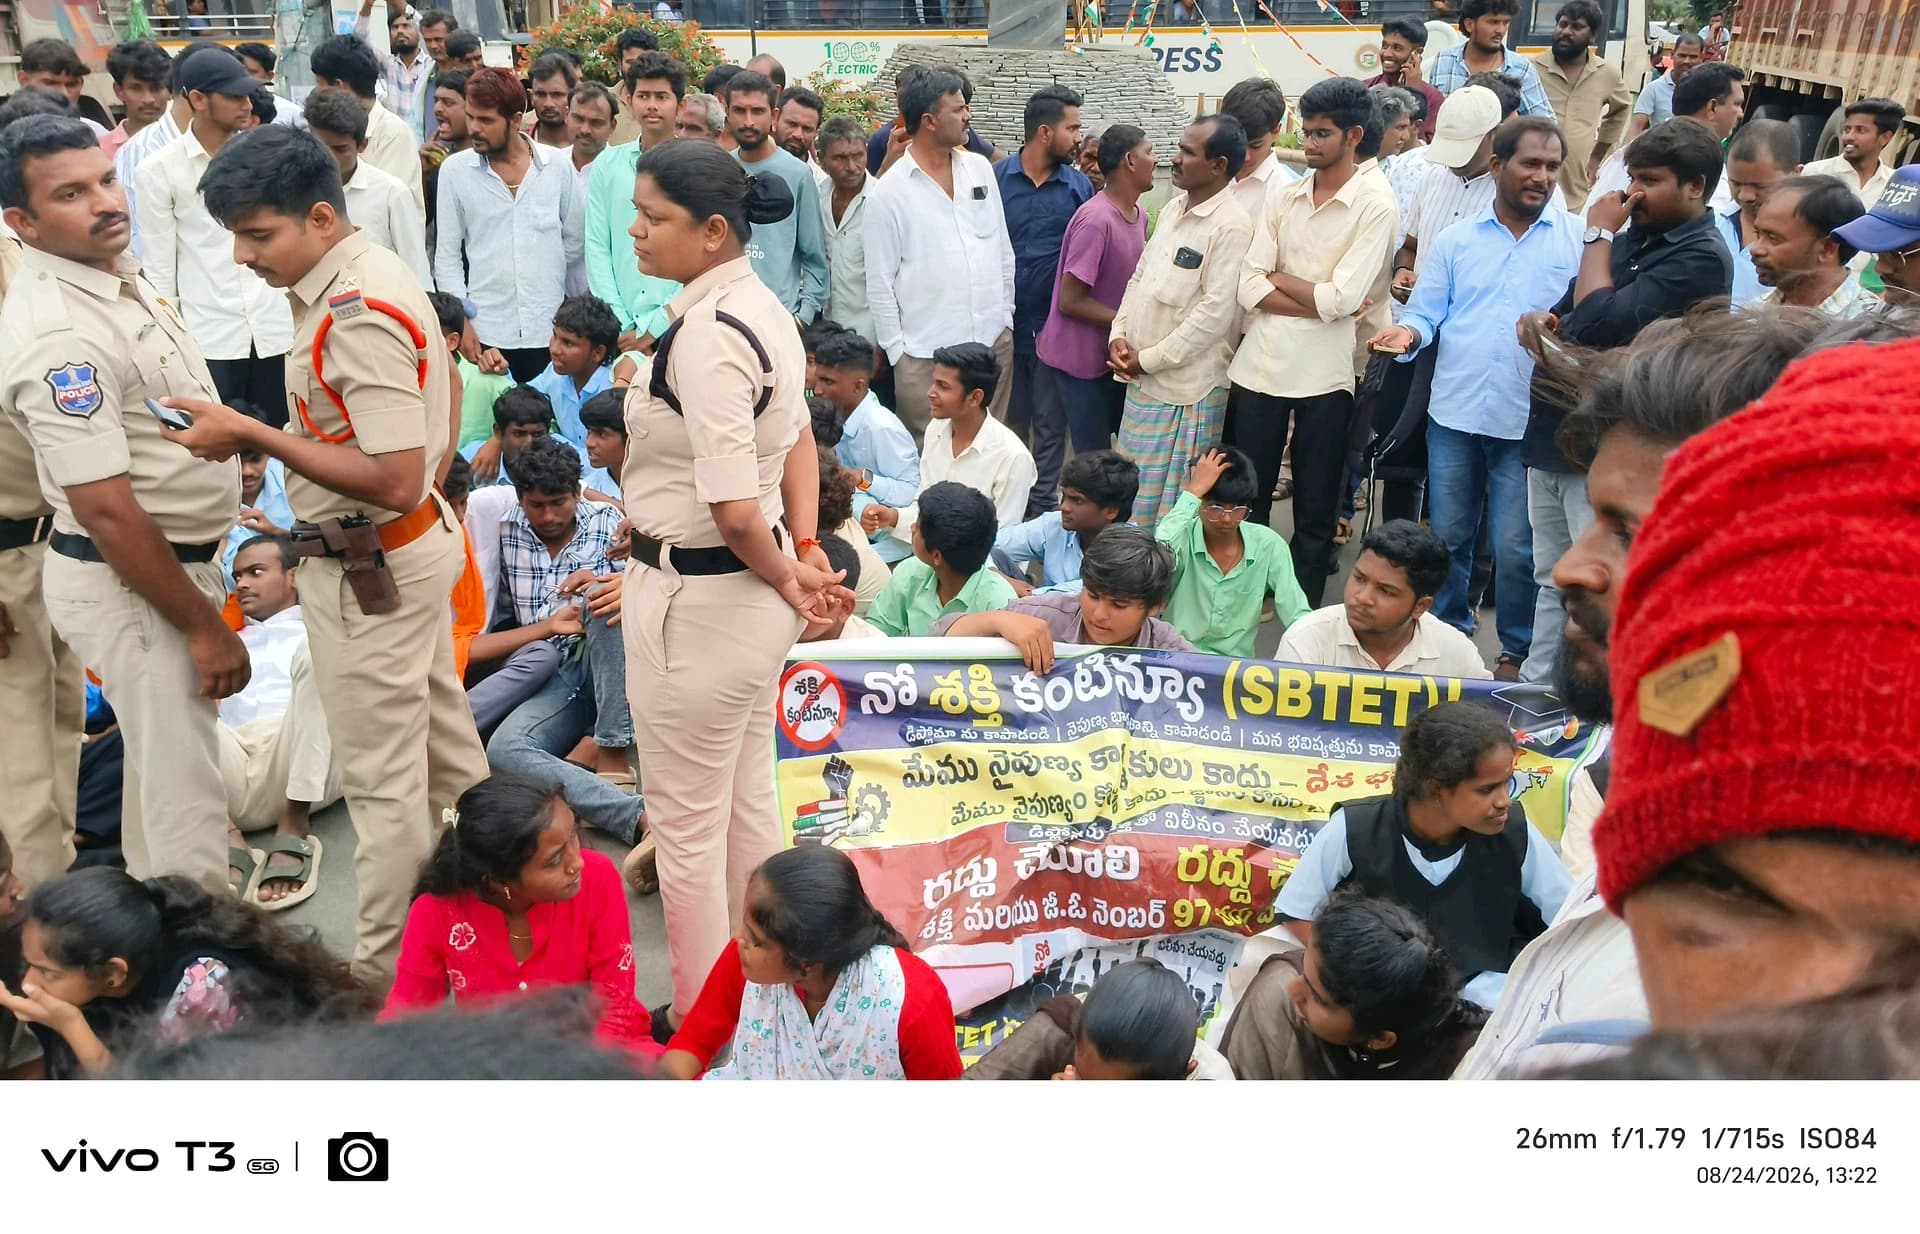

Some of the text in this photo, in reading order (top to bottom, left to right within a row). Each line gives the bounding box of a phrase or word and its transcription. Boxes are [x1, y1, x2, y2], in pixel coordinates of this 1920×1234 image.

[861, 663, 918, 715] నో
[929, 663, 1004, 728] శక్తి
[1011, 651, 1205, 723] కంటిన్యూ
[906, 726, 956, 744] డిప్లోమా
[960, 728, 978, 740] ను
[983, 725, 1050, 740] కాపాడండి
[1164, 721, 1232, 742] కాపాడండి
[1252, 729, 1283, 747] మన
[901, 751, 979, 789] మేము
[987, 748, 1083, 791] నైపుణ్య
[1202, 761, 1272, 789] కాదు
[951, 800, 1005, 827] మేము
[1013, 790, 1088, 823] నైపుణ్యం
[1164, 807, 1226, 835] విలీనం
[1177, 844, 1252, 904] రద్దు
[919, 907, 954, 943] శక్తి
[964, 892, 1039, 931] మరియు
[1091, 897, 1167, 929] నెంబర్
[1173, 898, 1212, 928] 97
